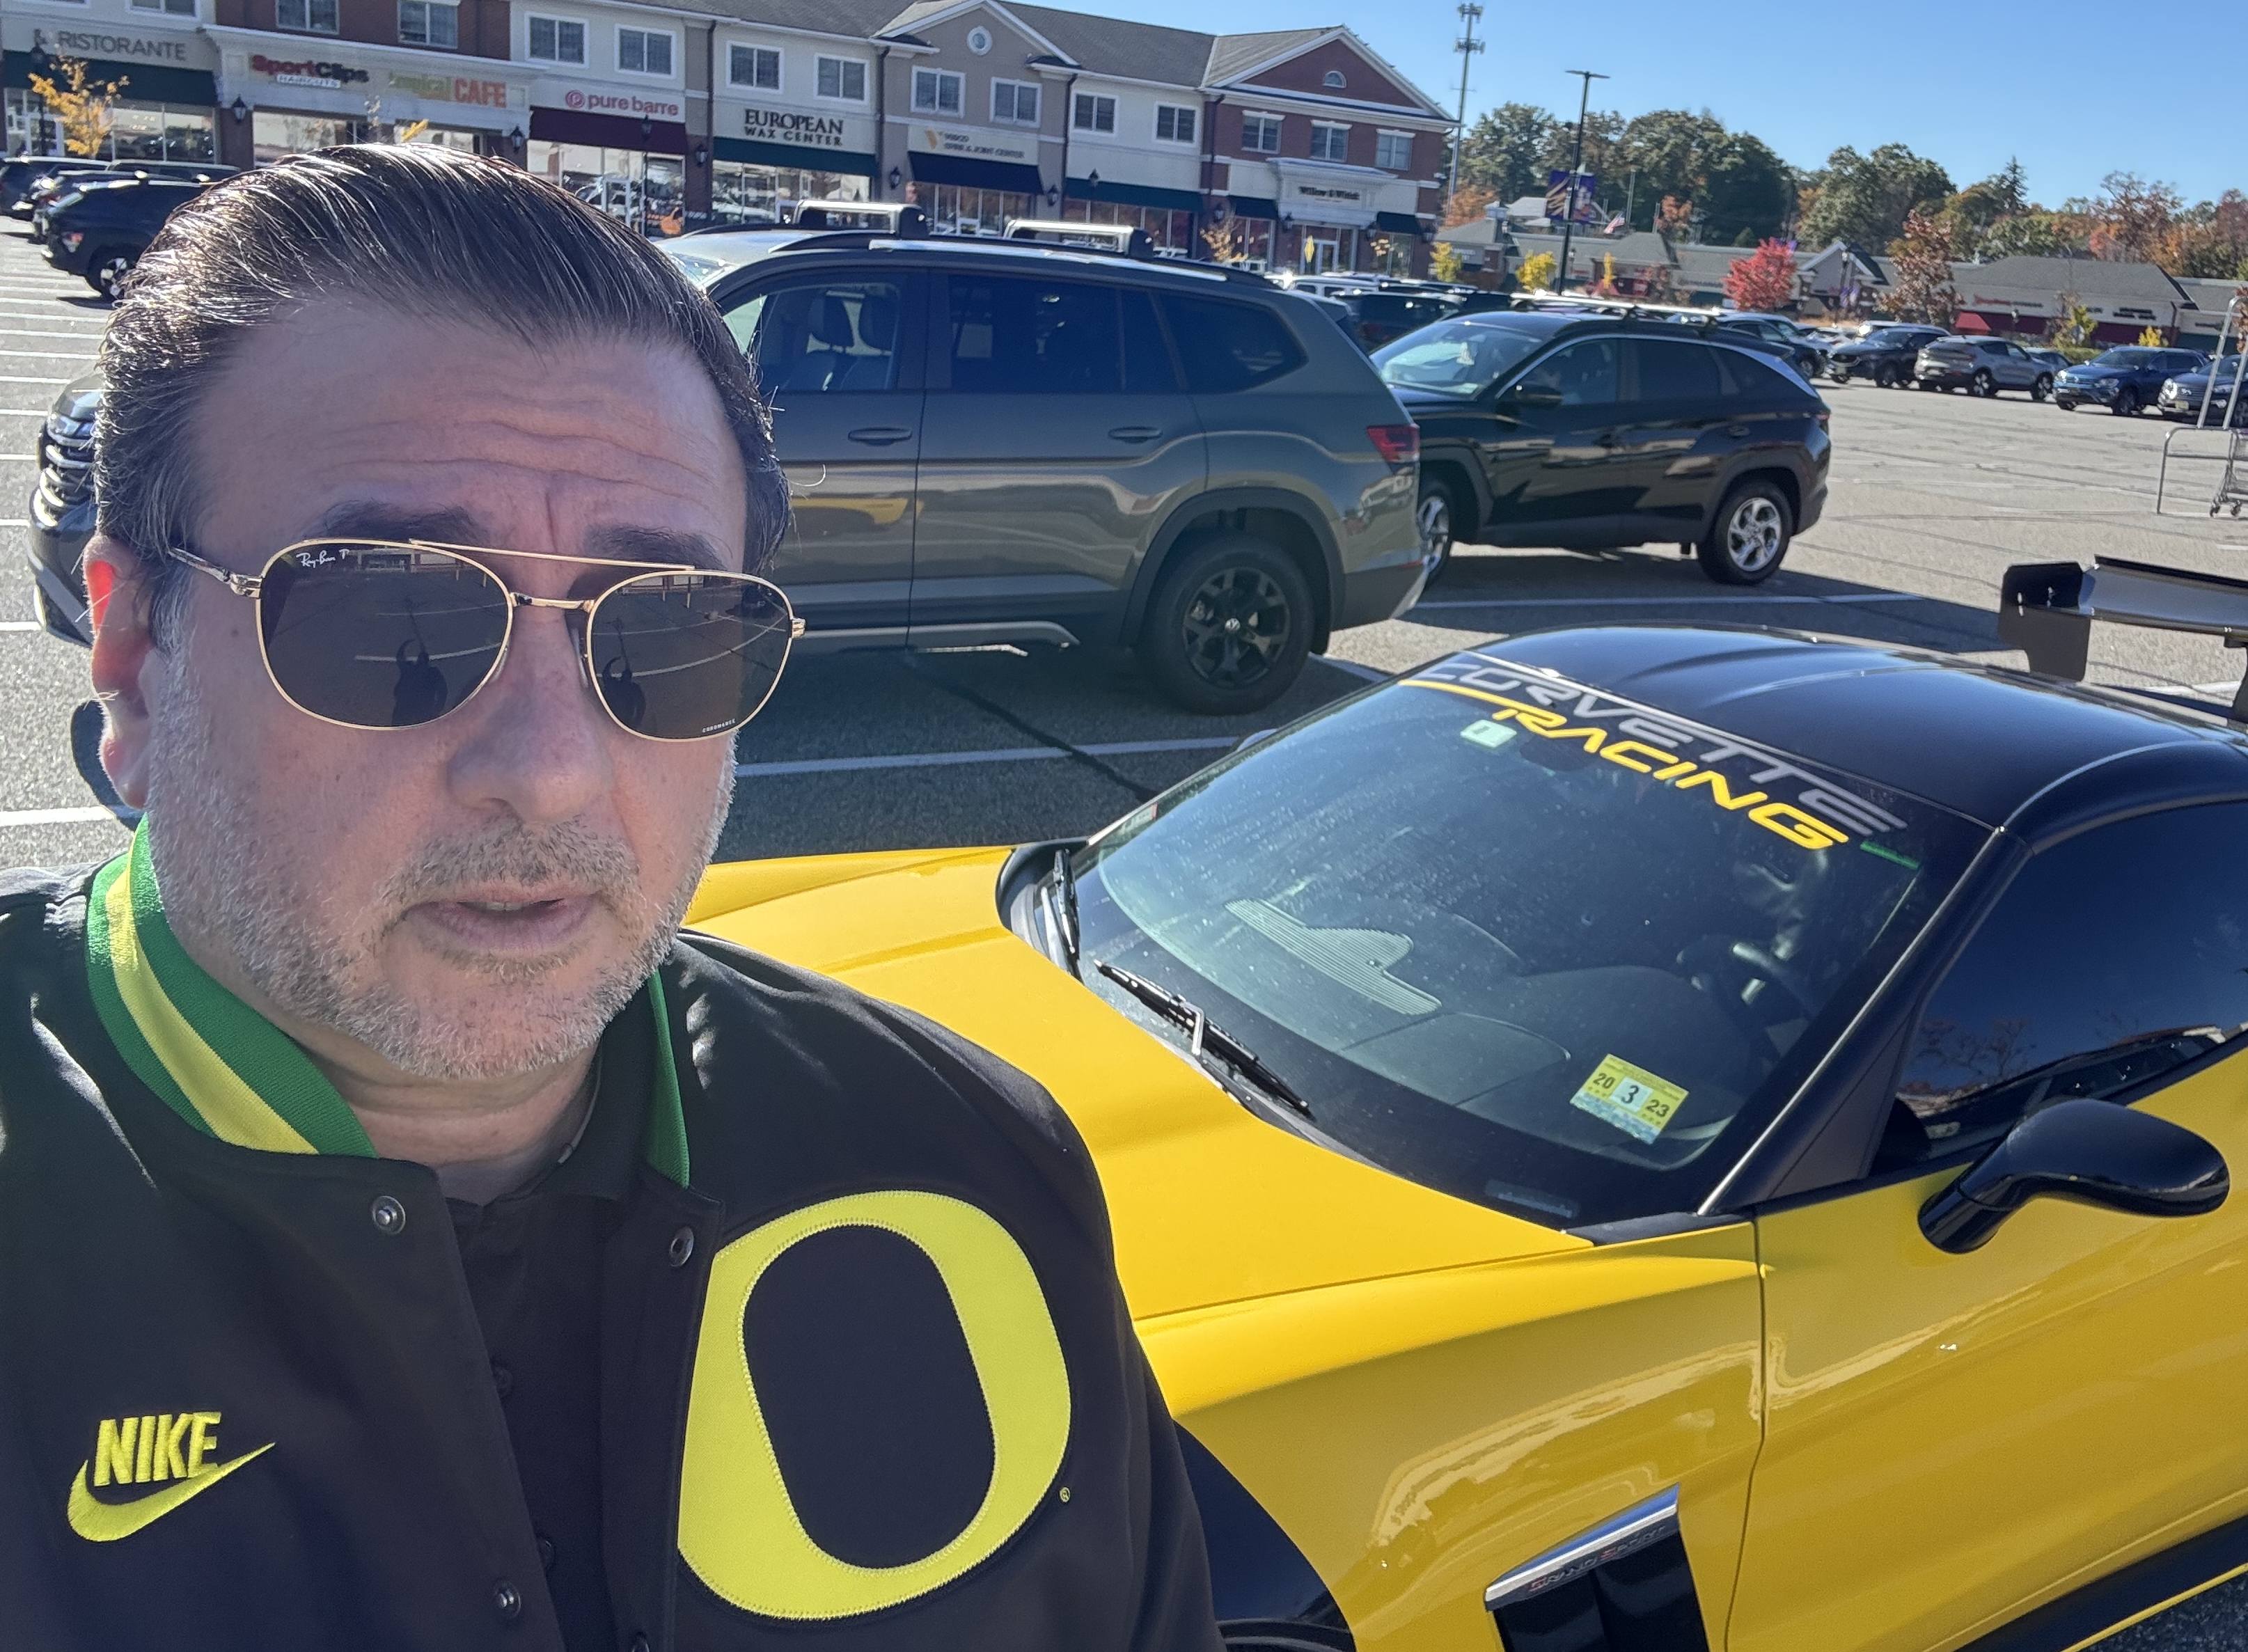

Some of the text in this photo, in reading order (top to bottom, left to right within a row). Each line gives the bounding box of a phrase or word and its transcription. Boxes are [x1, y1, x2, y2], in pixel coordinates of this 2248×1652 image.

[57, 30, 187, 61] RISTORANTE
[455, 77, 507, 109] CAFE
[588, 94, 629, 110] pure
[632, 96, 679, 116] barre
[744, 126, 842, 146] WAX CENTER
[745, 109, 844, 135] EUROPEAN
[296, 550, 336, 568] Ray-Ban
[1412, 663, 1908, 835] CORVETTE
[1469, 696, 1849, 849] RACING
[1593, 1073, 1616, 1089] 20
[1621, 1085, 1639, 1103] 3
[1646, 1099, 1670, 1117] 23
[93, 1411, 222, 1487] NIKE
